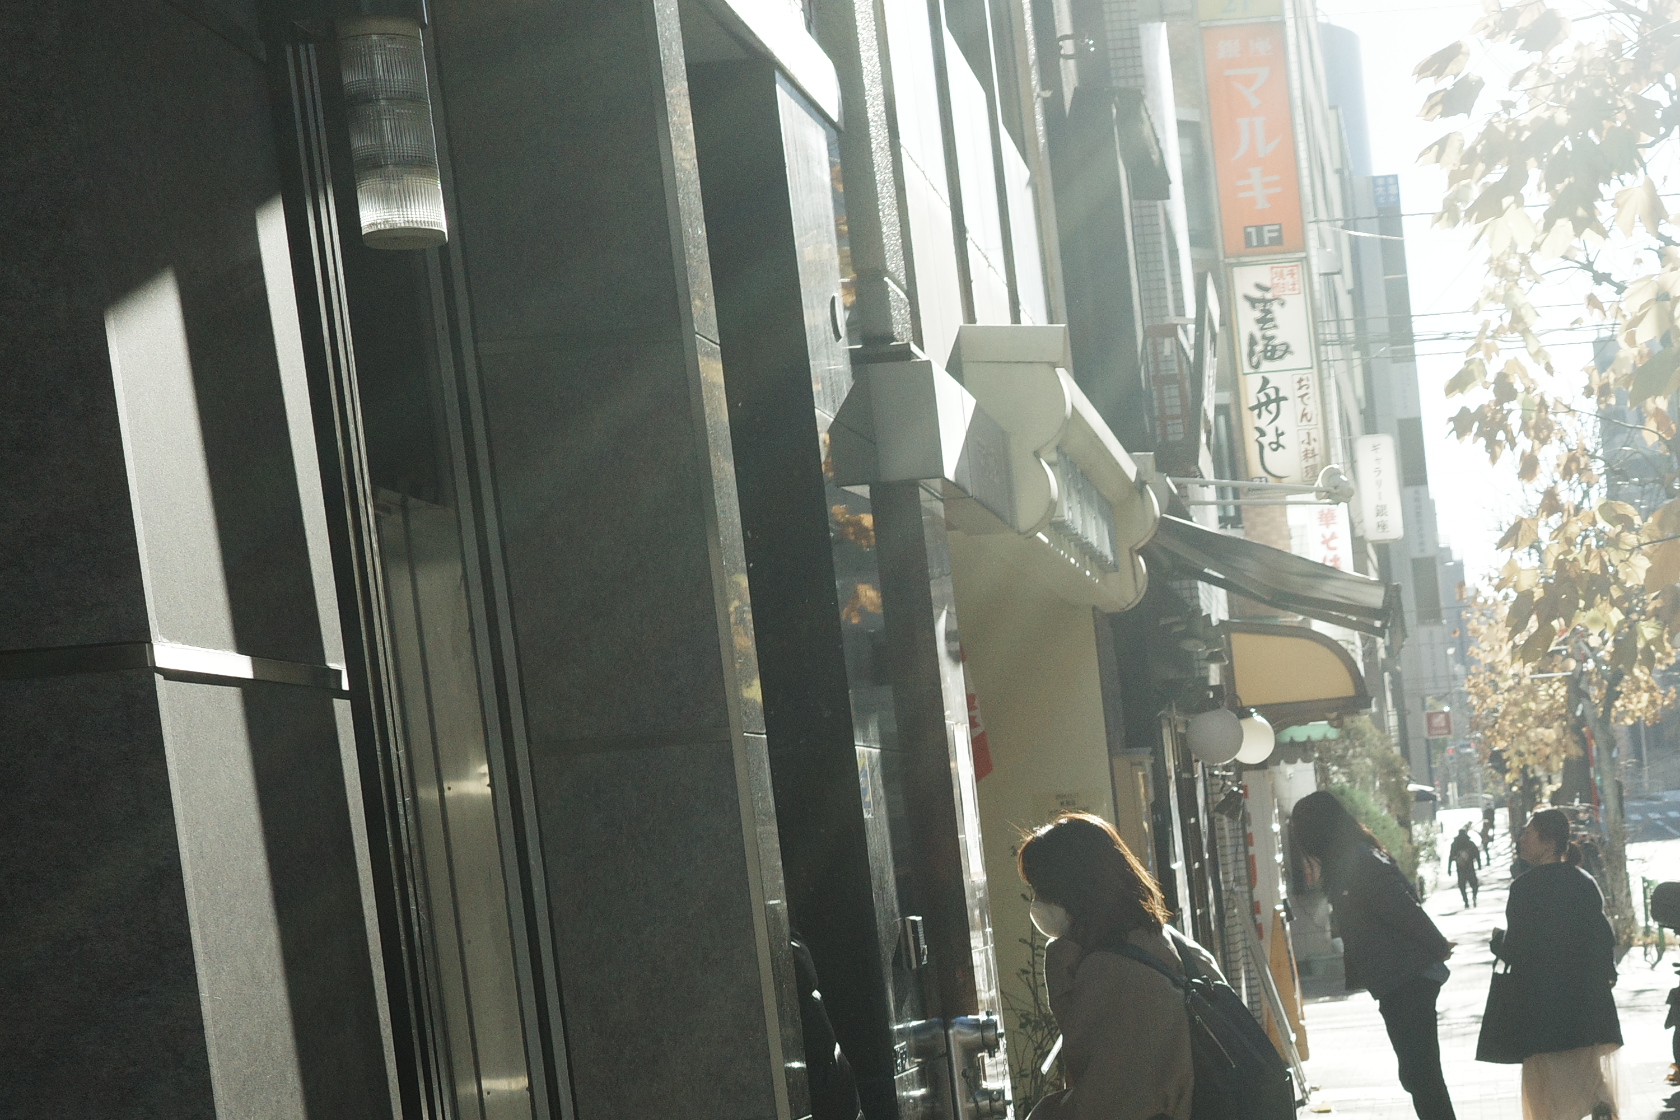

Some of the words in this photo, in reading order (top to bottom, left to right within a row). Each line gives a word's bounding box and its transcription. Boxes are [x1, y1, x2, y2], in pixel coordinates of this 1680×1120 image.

[1222, 66, 1283, 210] マルキ
[1245, 224, 1280, 247] 1F
[1296, 376, 1313, 424] おでん
